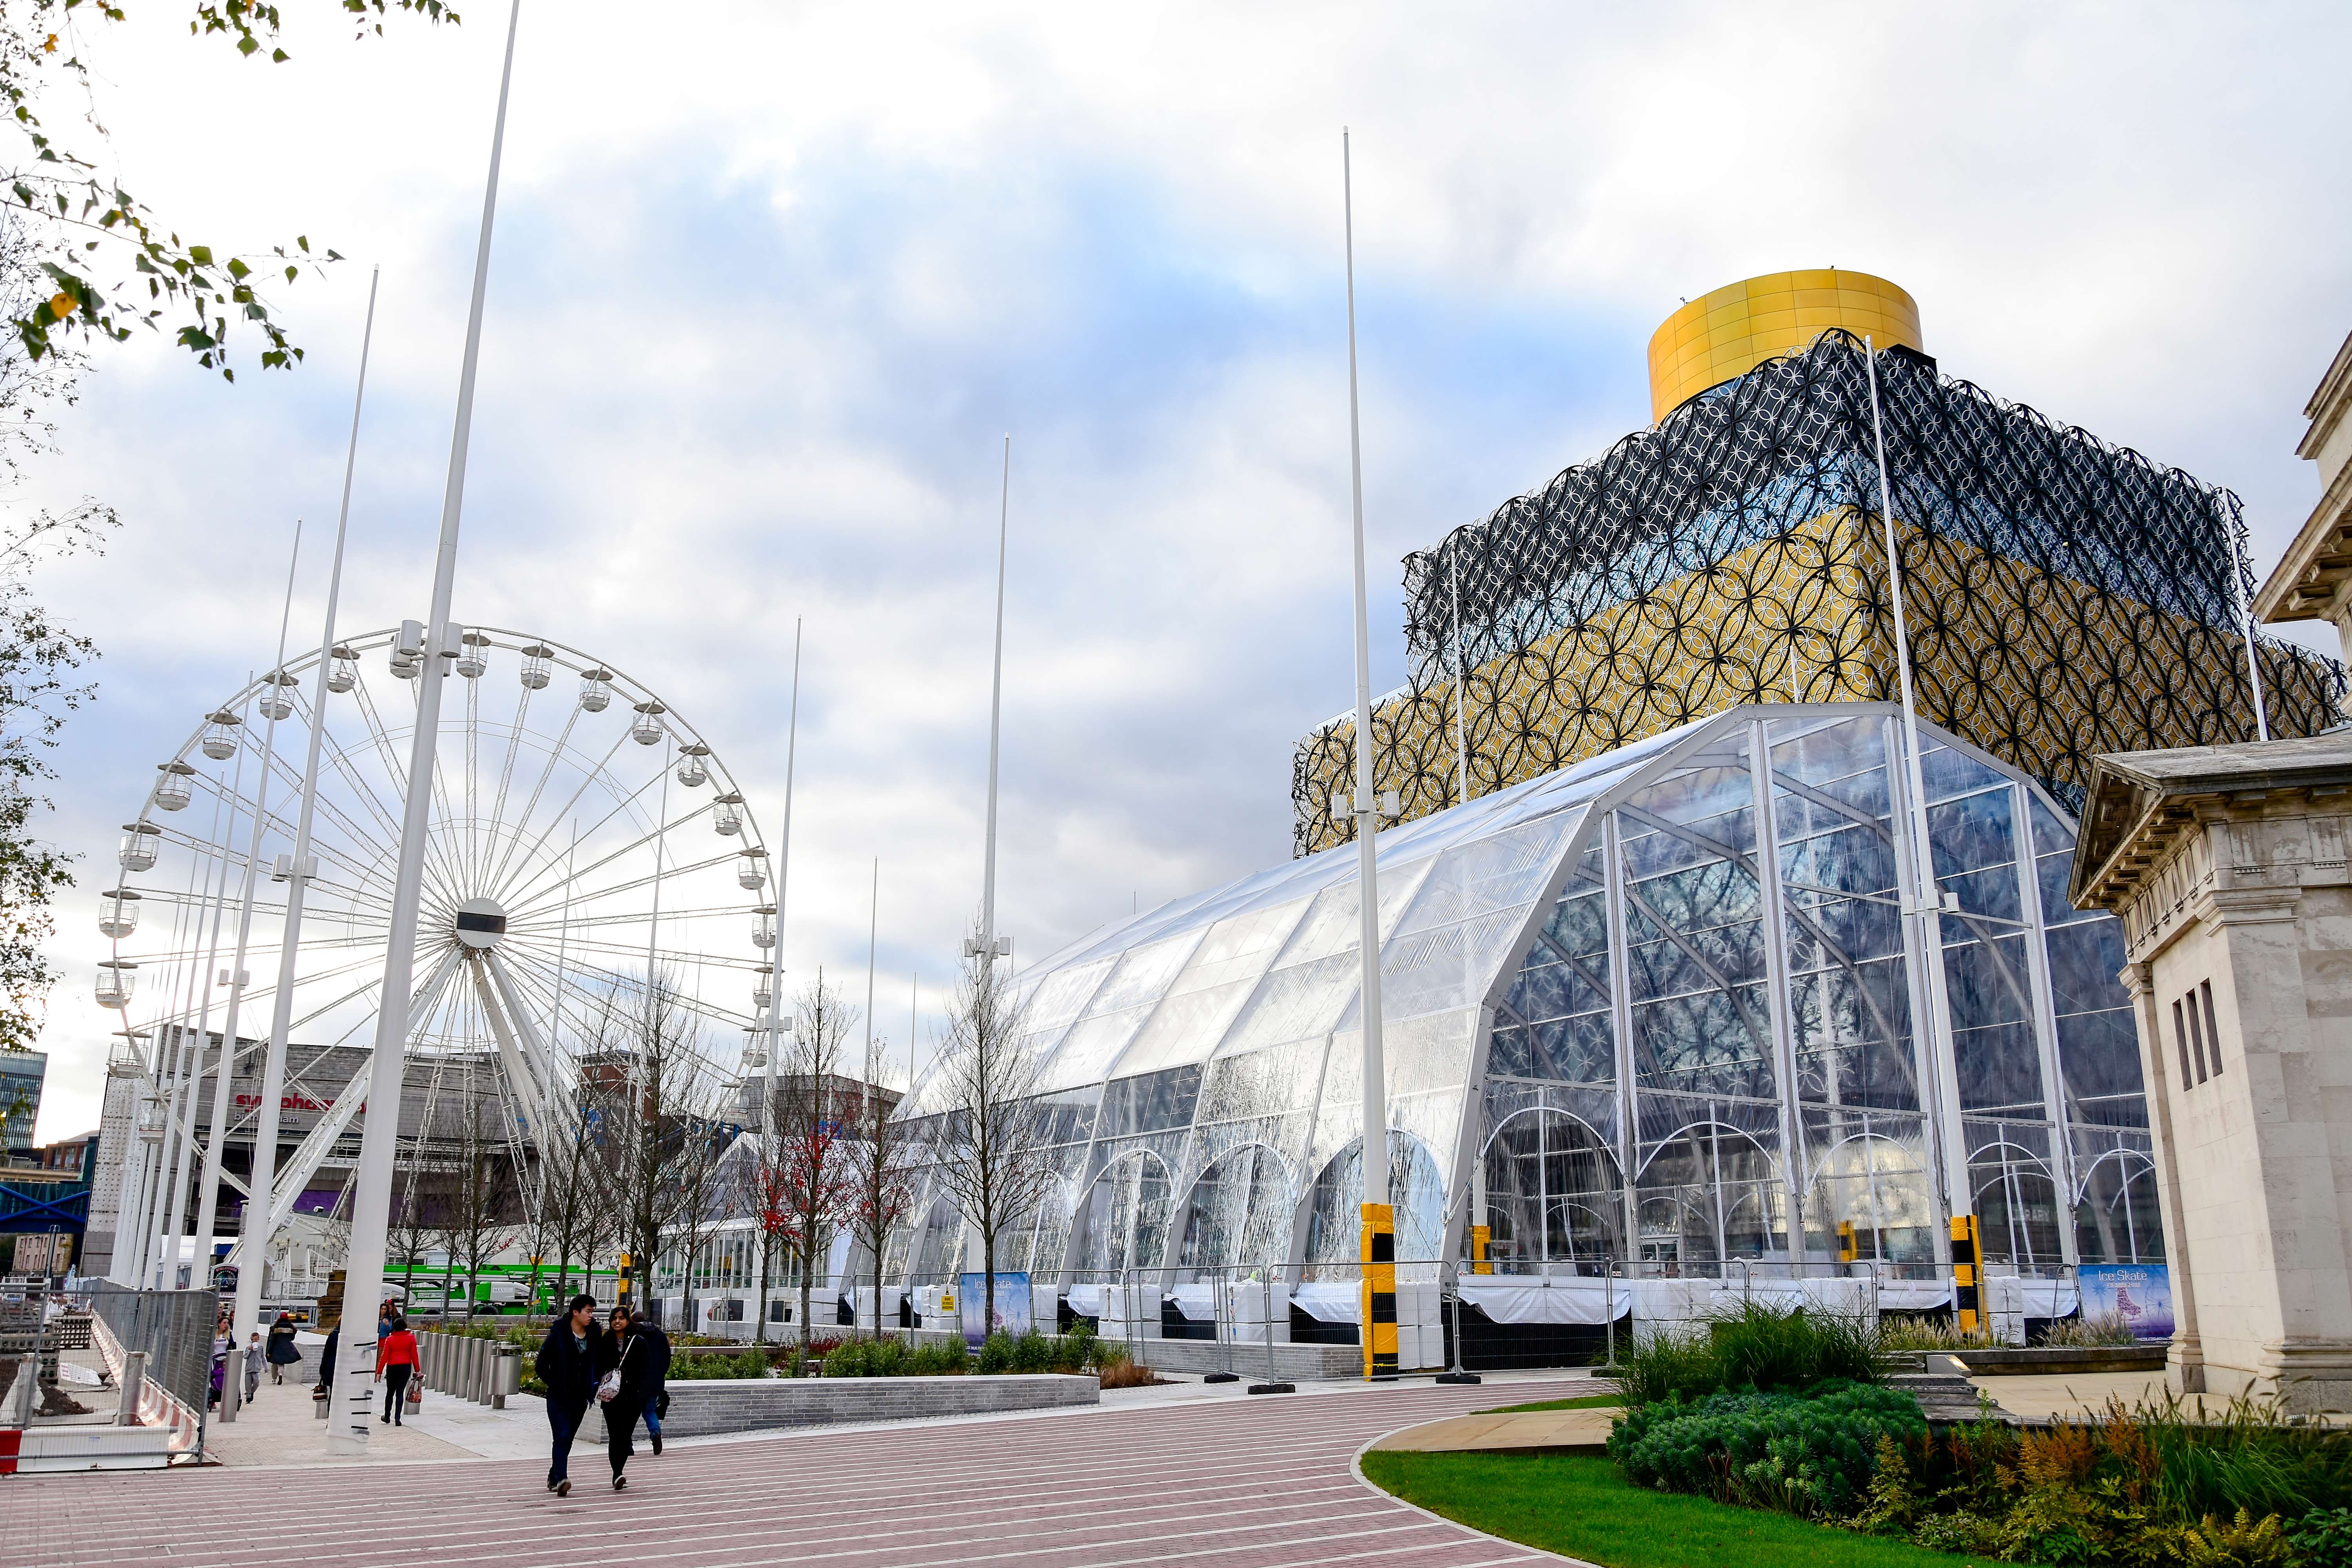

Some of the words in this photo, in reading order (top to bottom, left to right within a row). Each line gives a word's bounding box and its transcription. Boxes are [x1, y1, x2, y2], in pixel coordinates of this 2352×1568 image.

[236, 1093, 336, 1112] syphon
[2098, 1270, 2114, 1281] Ice
[2117, 1270, 2147, 1281] Skate
[975, 1278, 985, 1289] Ice
[993, 1279, 1011, 1289] kate
